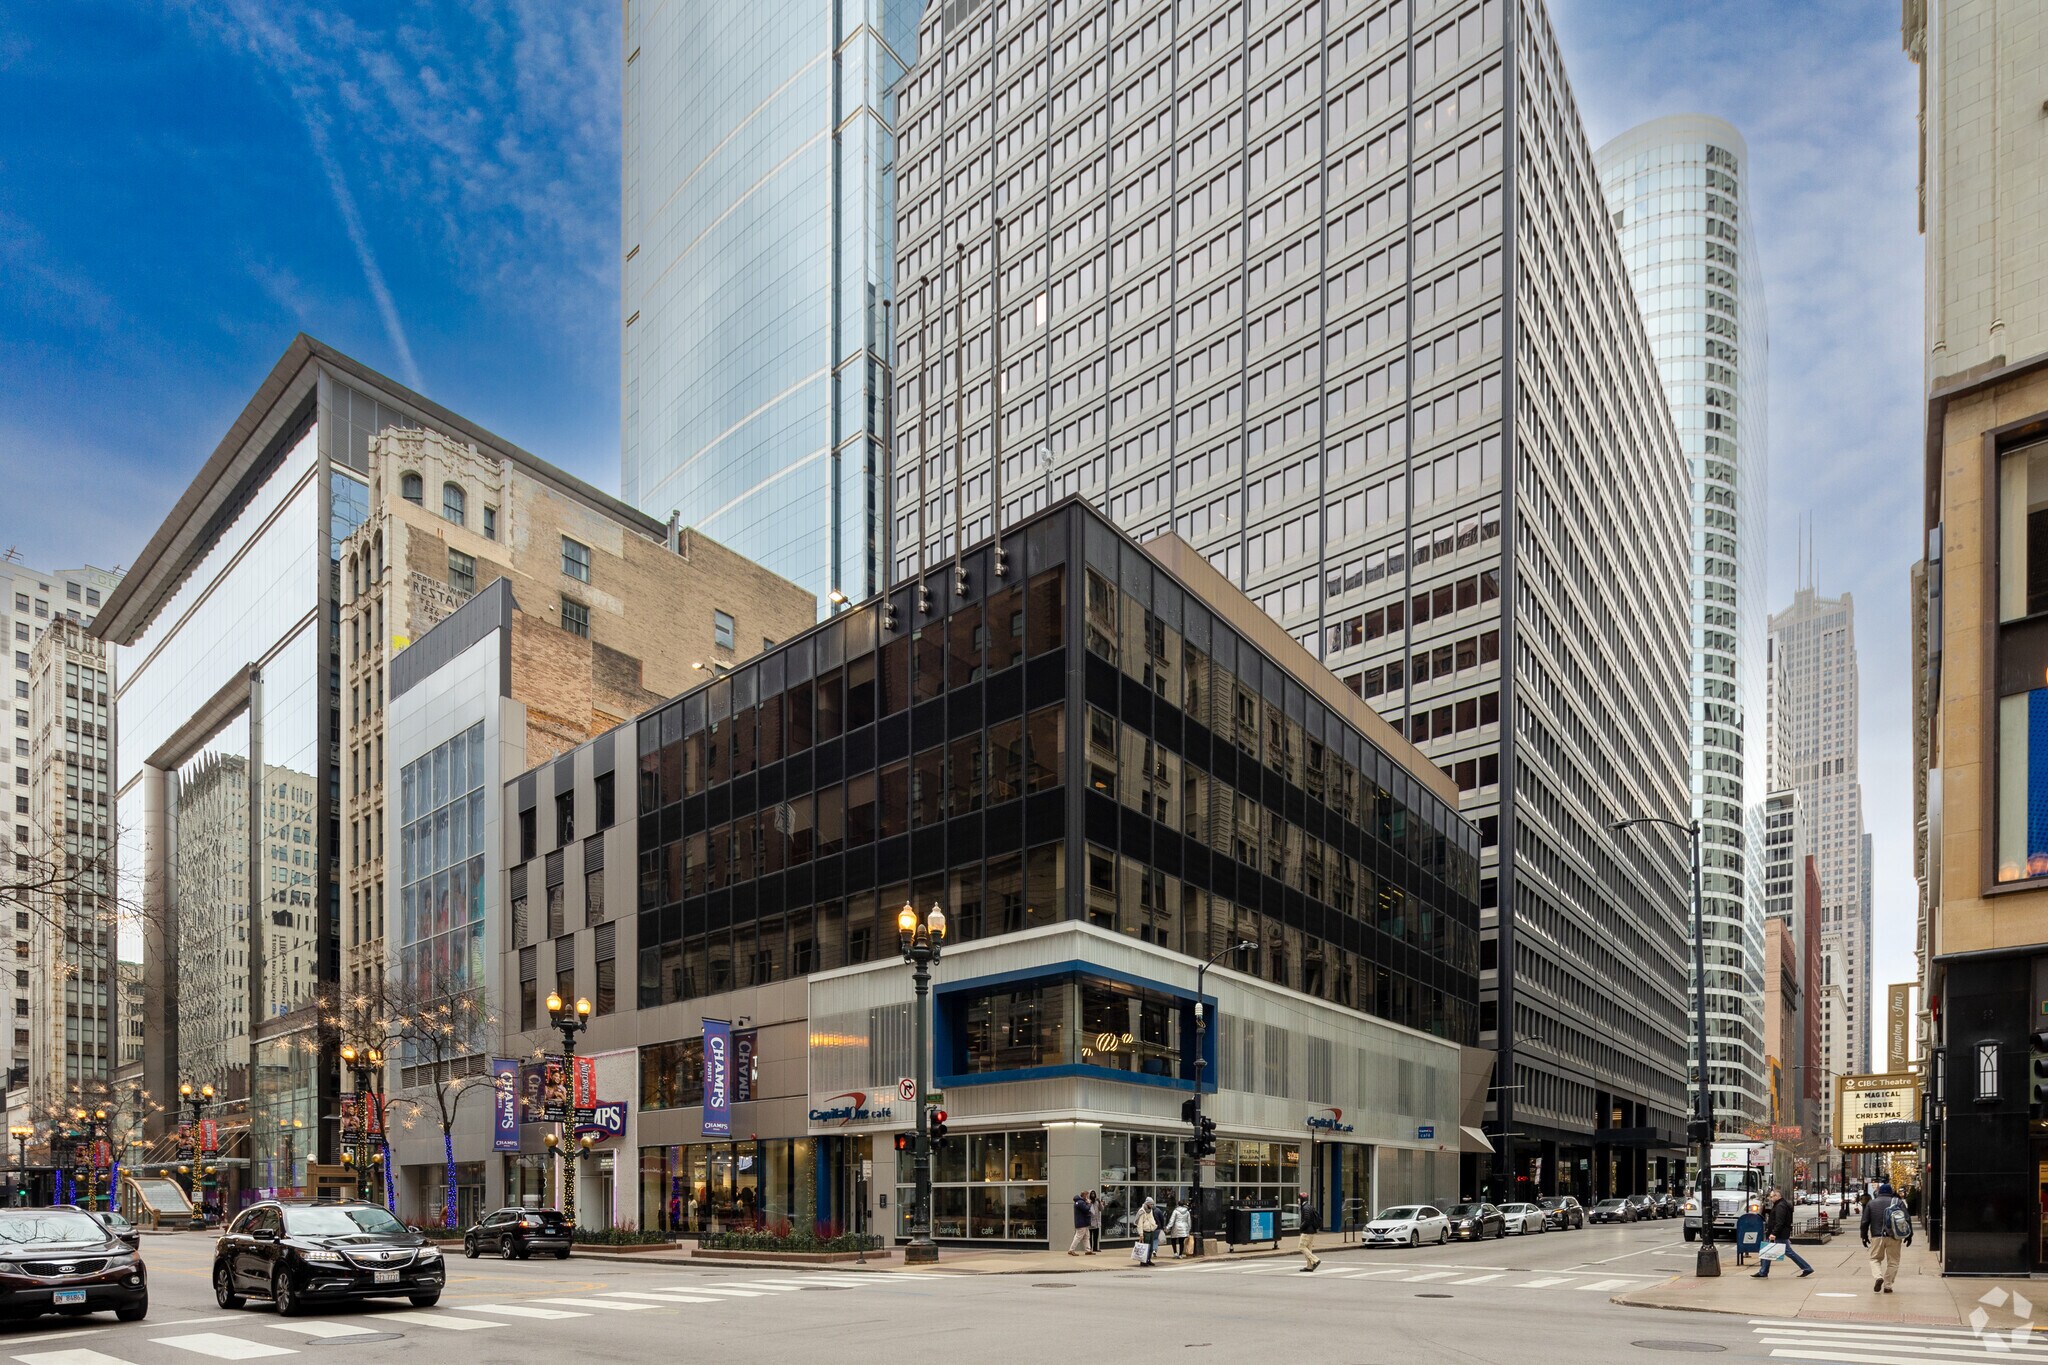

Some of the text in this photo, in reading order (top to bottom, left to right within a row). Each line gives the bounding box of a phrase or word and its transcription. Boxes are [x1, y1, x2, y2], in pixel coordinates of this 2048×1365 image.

[1891, 991, 1905, 1065] Hampton Inn
[710, 1036, 724, 1108] CHAMPS
[579, 1060, 591, 1106] NUTCRACKER
[1857, 1078, 1912, 1087] CIBC Theatre
[500, 1071, 514, 1129] CHAMPS
[871, 1107, 891, 1118] café
[704, 1122, 728, 1130] CHAMPS
[939, 1226, 961, 1236] banking
[981, 1226, 994, 1235] café
[1017, 1226, 1037, 1236] coffee
